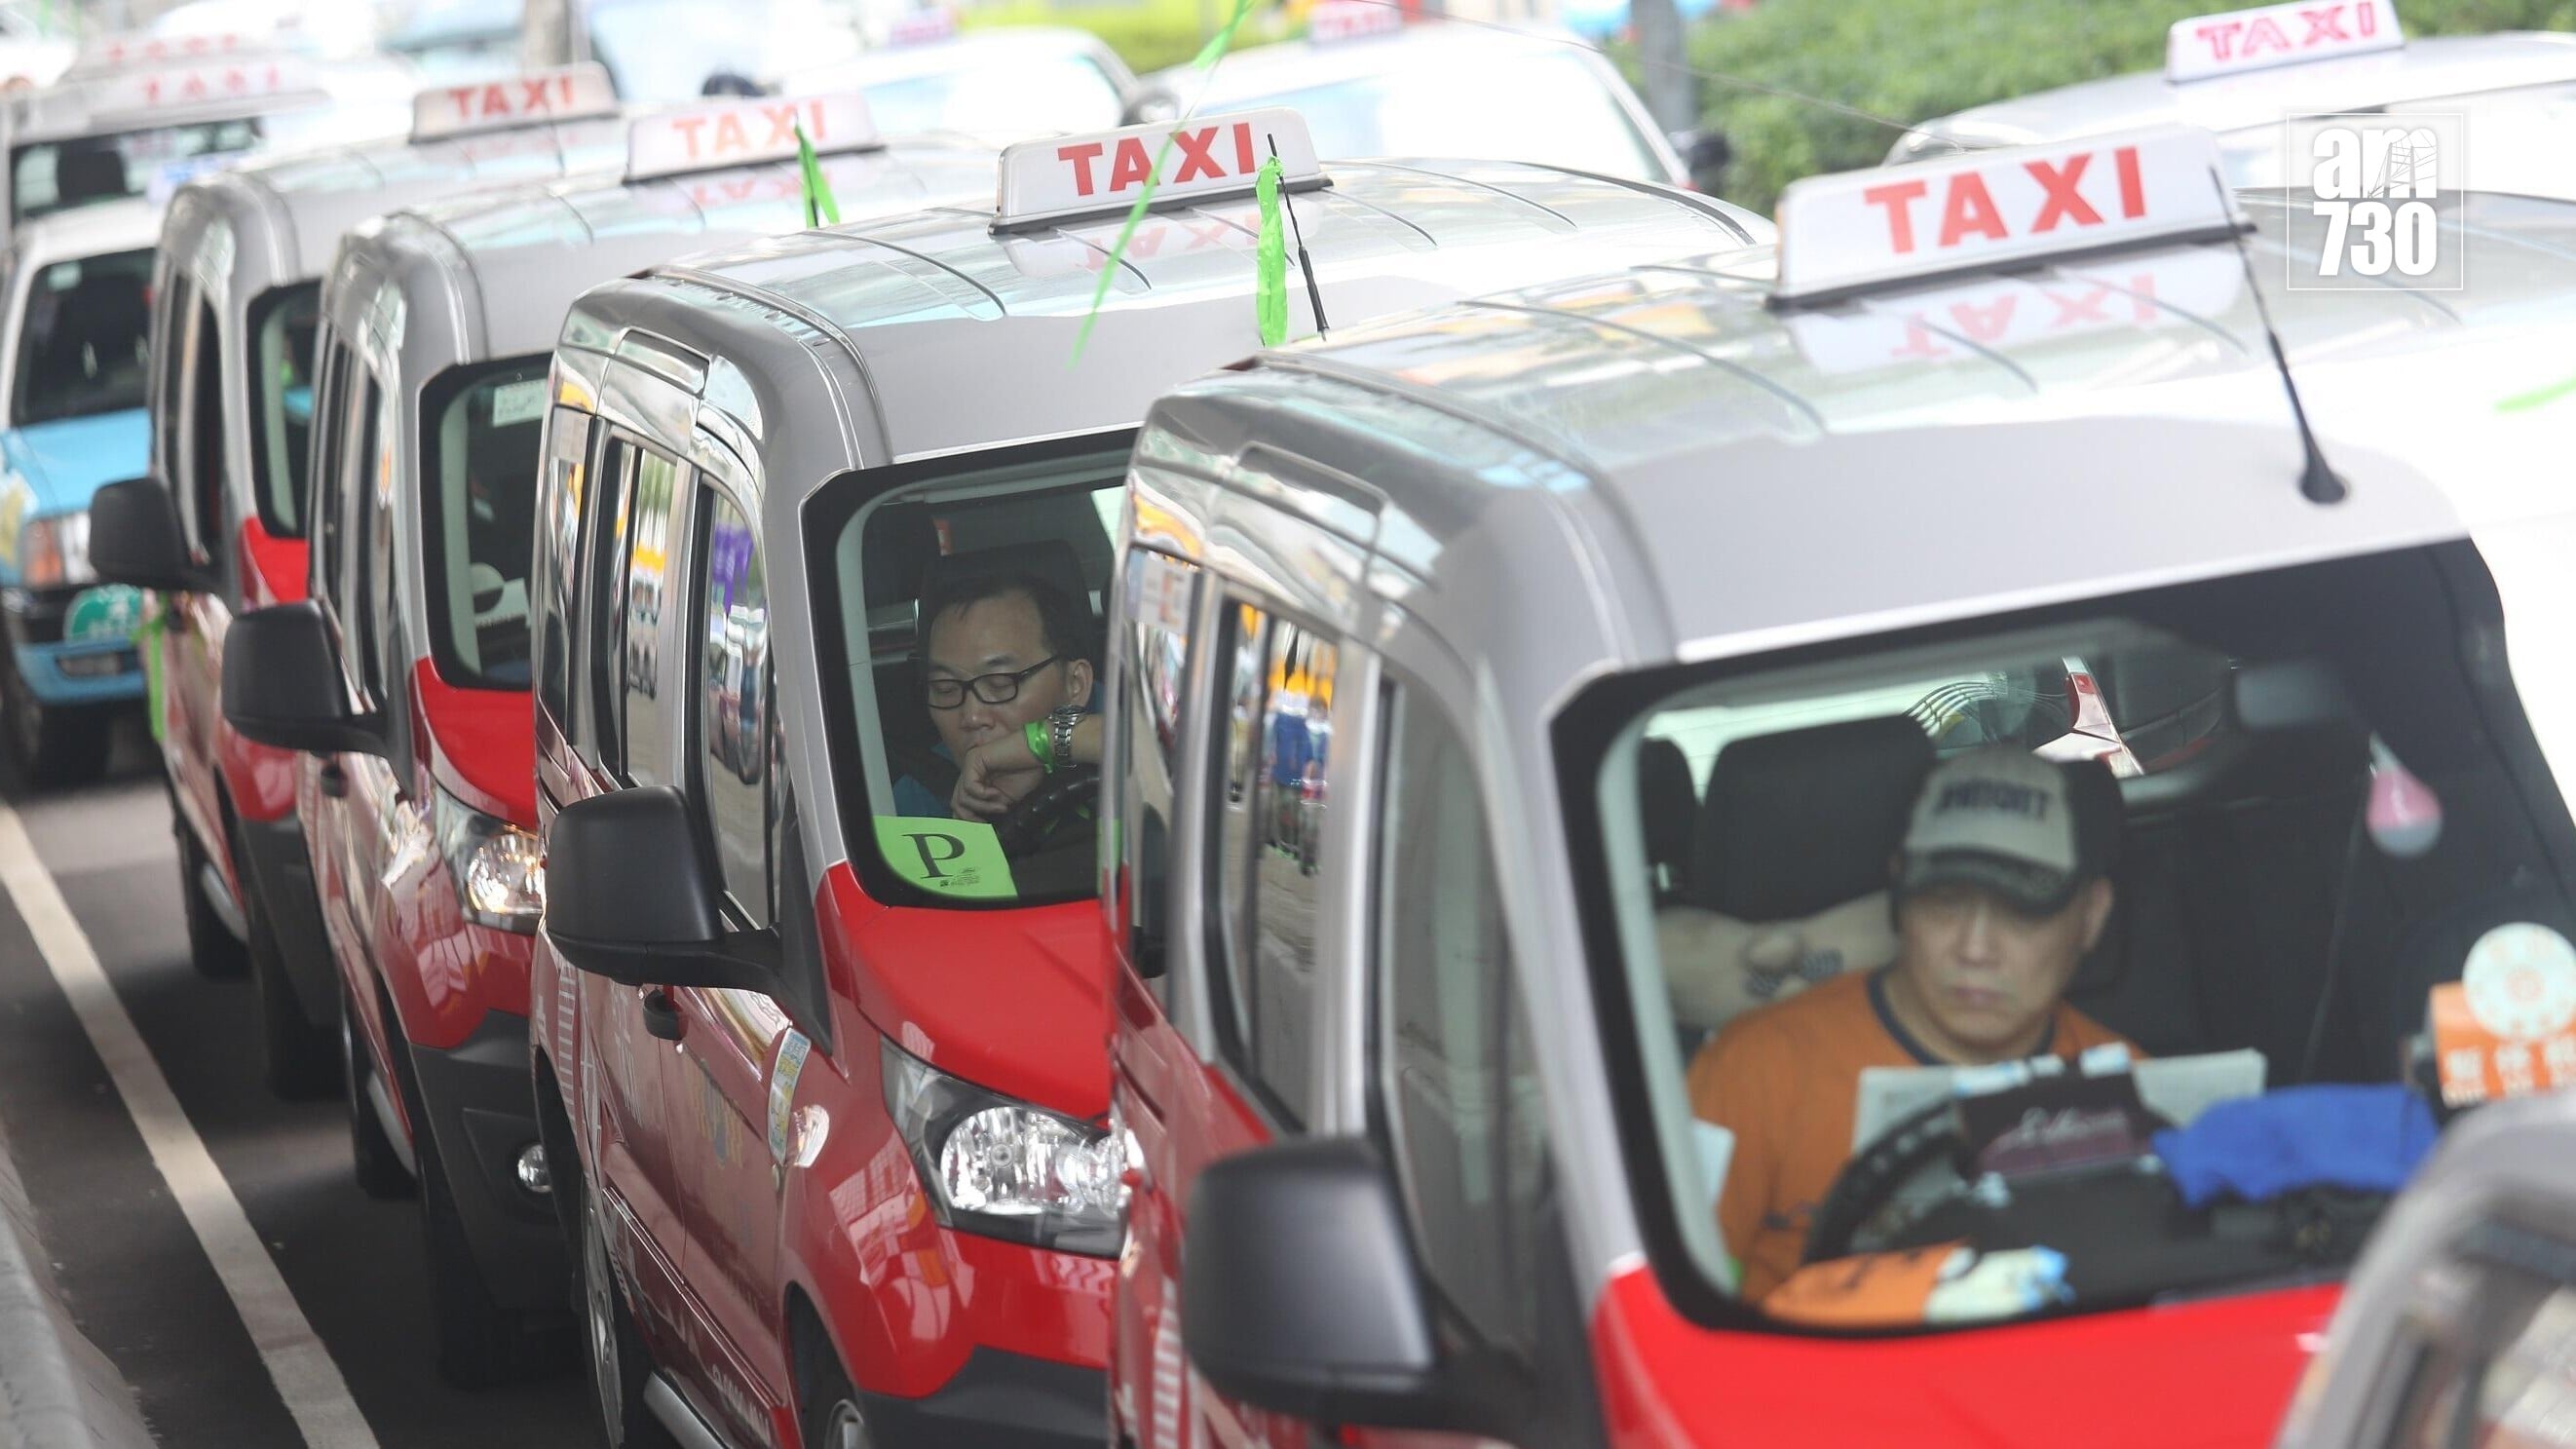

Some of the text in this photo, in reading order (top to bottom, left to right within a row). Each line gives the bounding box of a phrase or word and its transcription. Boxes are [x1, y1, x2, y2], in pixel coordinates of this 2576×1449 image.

[2196, 1, 2377, 61] TAXI
[446, 75, 574, 118] TAXI
[671, 98, 826, 159] TAXI
[1057, 122, 1256, 196] TAXI
[1863, 145, 2148, 254] TAXI
[900, 833, 966, 879] P
